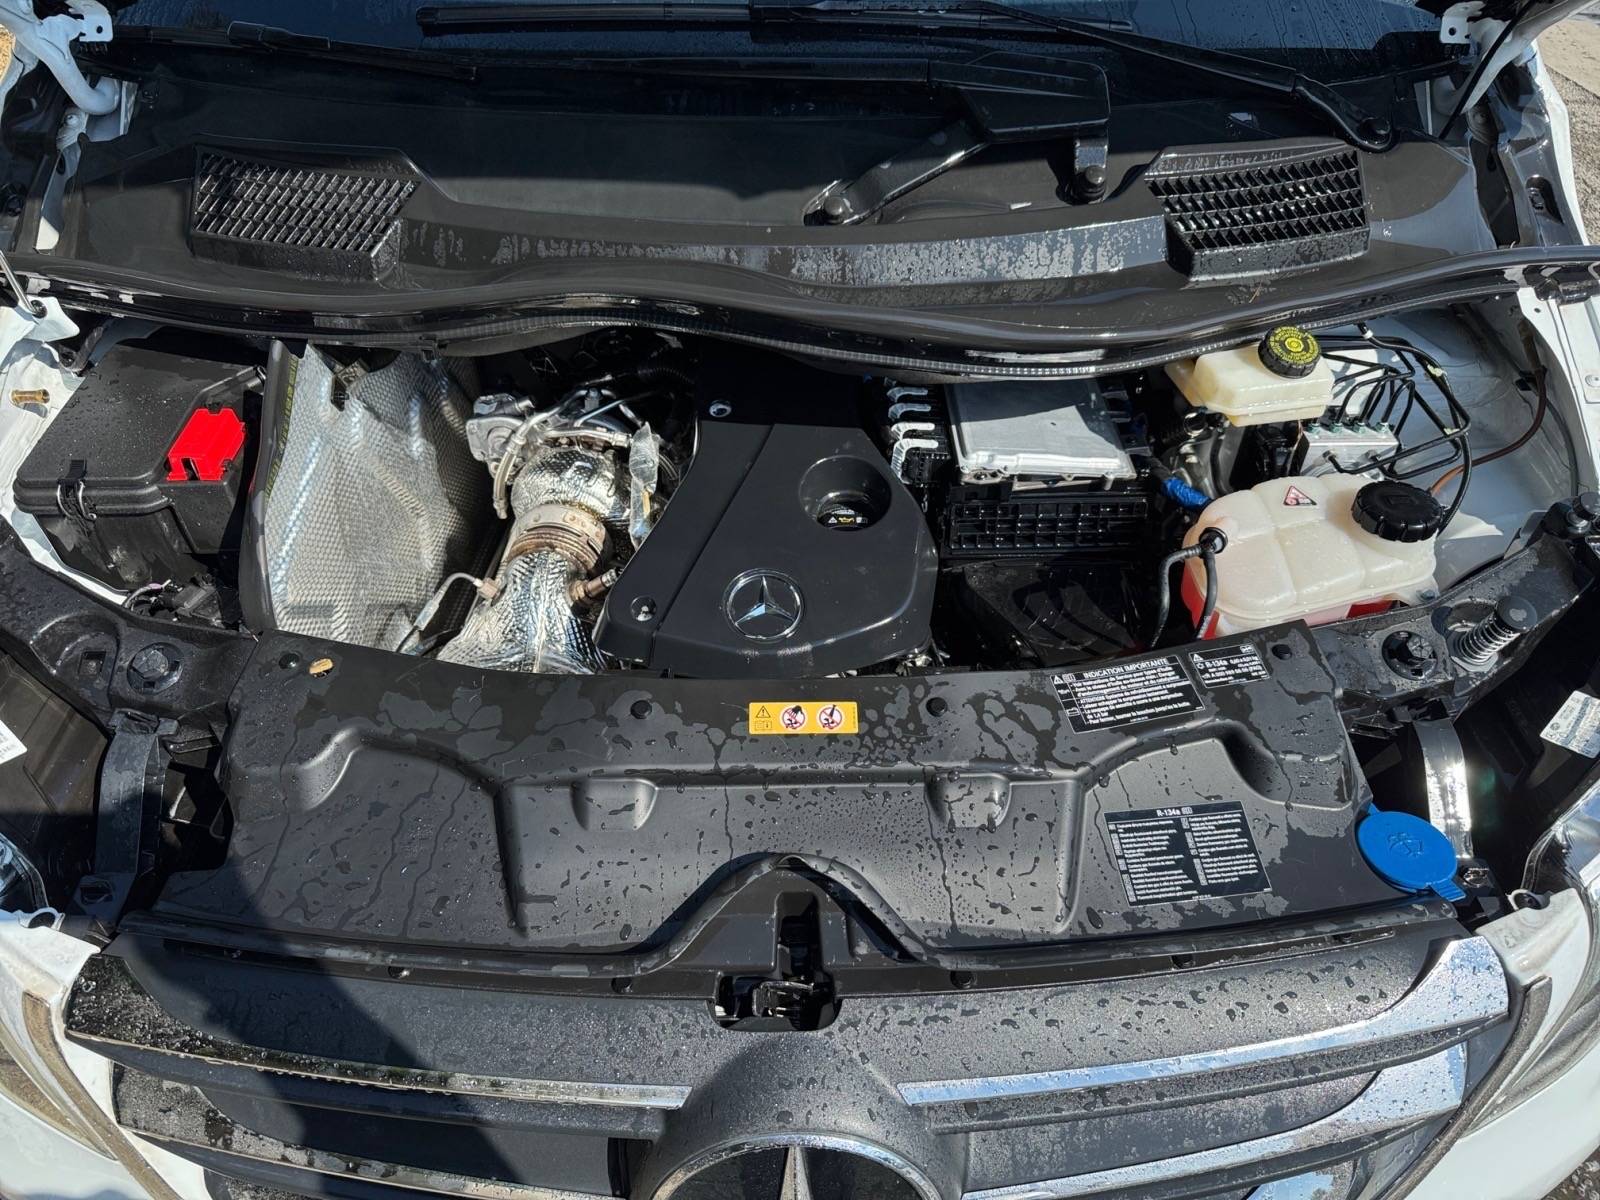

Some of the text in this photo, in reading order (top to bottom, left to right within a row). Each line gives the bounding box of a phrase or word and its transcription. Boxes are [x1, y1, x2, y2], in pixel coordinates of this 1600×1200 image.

[1083, 666, 1125, 680] INDICATION
[1124, 658, 1169, 672] IMPORTANTE
[1156, 808, 1181, 817] R-134a
